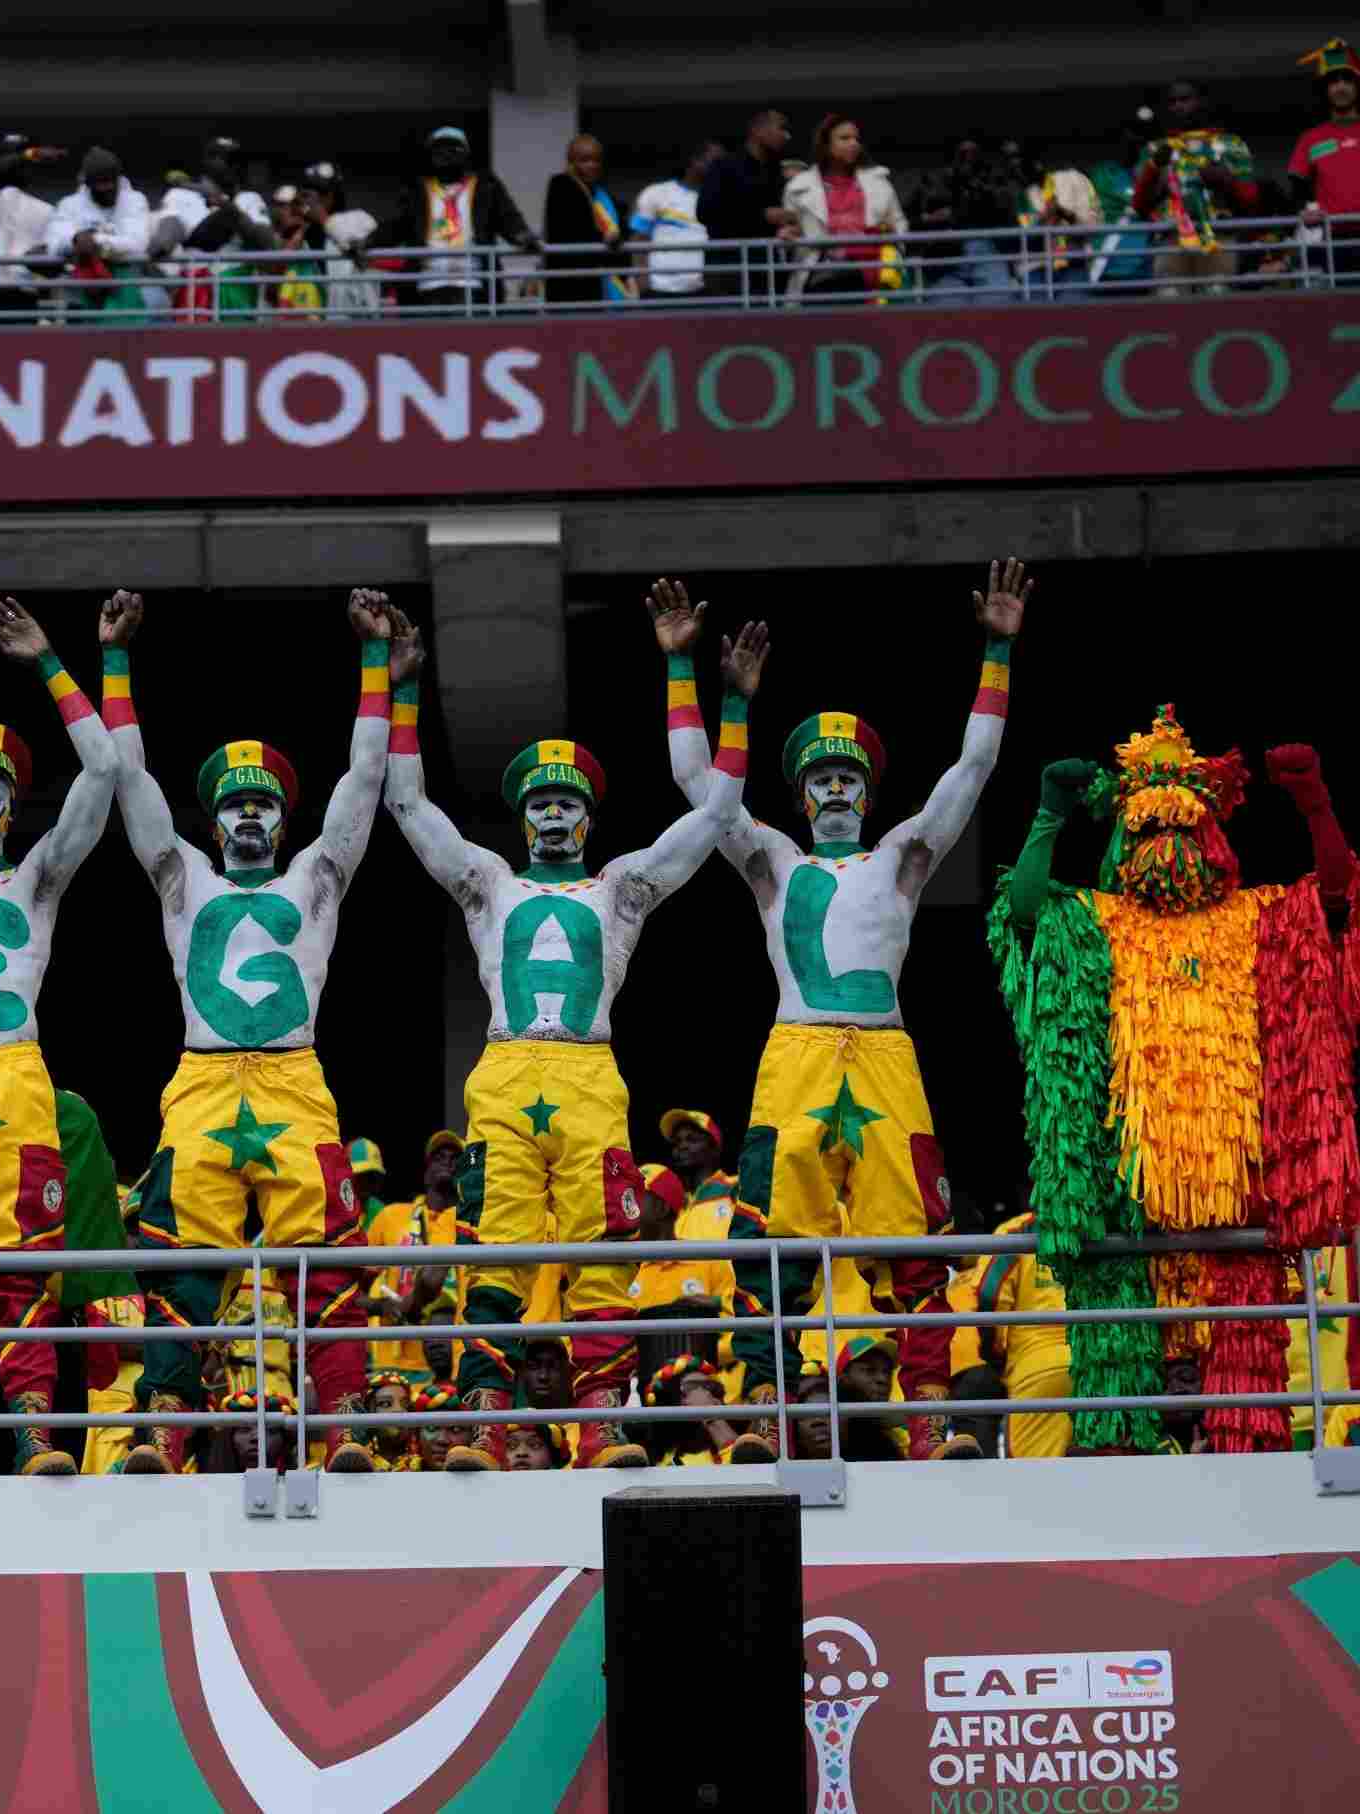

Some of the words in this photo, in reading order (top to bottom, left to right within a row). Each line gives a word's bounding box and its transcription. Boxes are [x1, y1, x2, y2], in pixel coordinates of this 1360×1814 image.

[572, 328, 1291, 431] MOROCCO
[933, 1666, 1058, 1698] CAF
[929, 1713, 1083, 1749] AFRICA
[1092, 1710, 1177, 1744] CUP
[929, 1753, 987, 1786] OF
[995, 1748, 1180, 1784] NATIONS
[930, 1785, 1132, 1814] MOROCCO
[1142, 1784, 1181, 1812] 25
